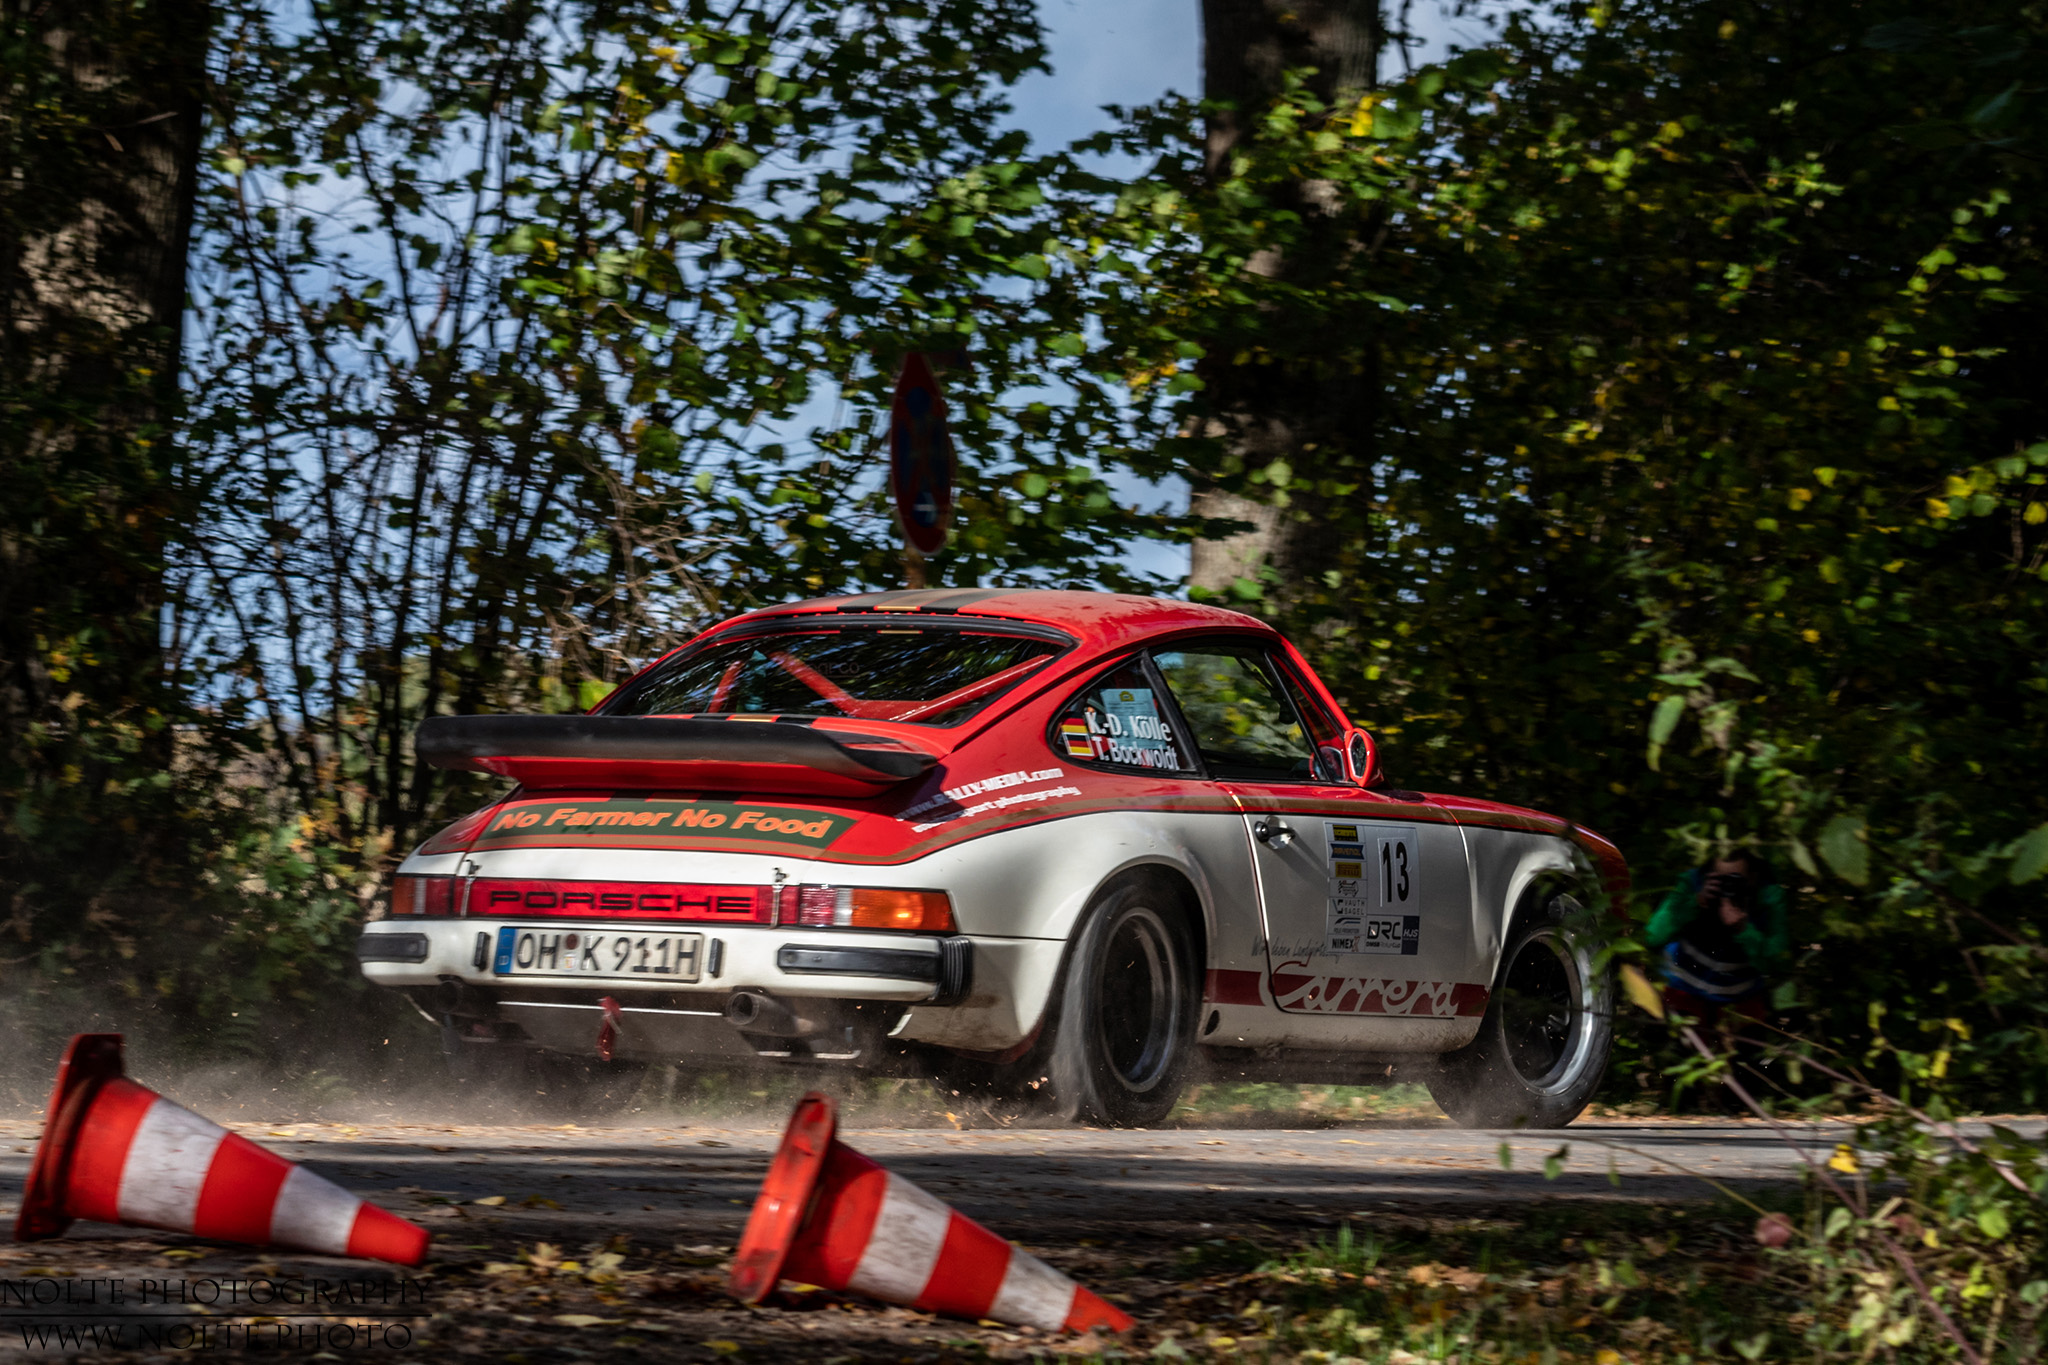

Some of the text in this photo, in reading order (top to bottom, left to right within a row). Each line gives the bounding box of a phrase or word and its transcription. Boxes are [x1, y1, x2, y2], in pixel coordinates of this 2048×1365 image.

[1084, 711, 1173, 742] K.-D. Kölle
[1091, 736, 1180, 770] T. Bockwoldt
[491, 807, 834, 839] No Farmer No Food
[1382, 841, 1410, 903] 13
[490, 890, 752, 914] PORSCHE
[1366, 921, 1402, 940] DRC
[1402, 928, 1419, 938] HJS
[516, 932, 698, 975] OH K 911H
[1258, 953, 1460, 1016] Carrera
